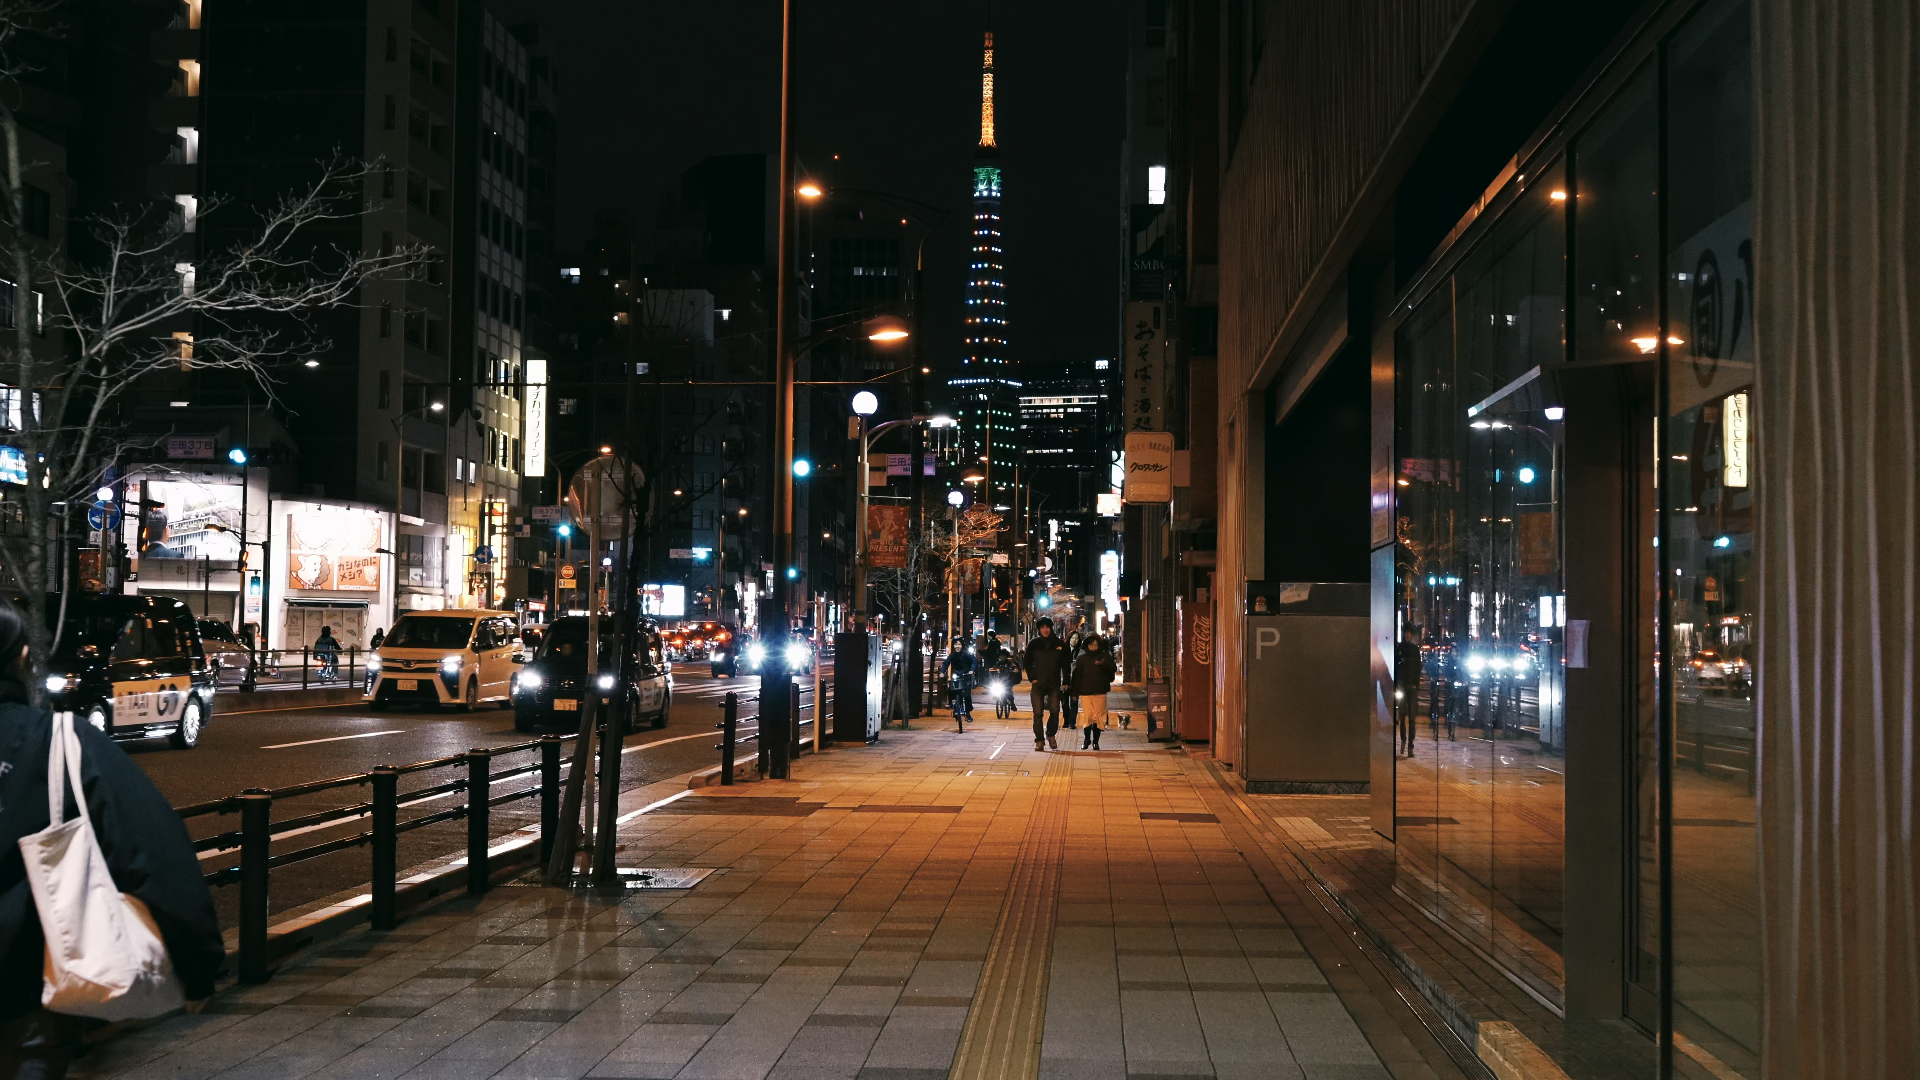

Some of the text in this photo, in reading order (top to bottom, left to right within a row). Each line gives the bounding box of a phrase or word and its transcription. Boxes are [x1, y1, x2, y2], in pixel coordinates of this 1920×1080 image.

[1131, 320, 1155, 431] おそばと酒処
[169, 440, 212, 449] 三田3丁目
[1148, 442, 1170, 453] BREAD
[889, 457, 933, 467] 三田目
[1130, 462, 1169, 473] クロワッサン
[337, 556, 377, 572] カシなのに
[1192, 612, 1210, 665] Coca-Cola
[1255, 627, 1281, 660] P
[157, 683, 178, 716] GO
